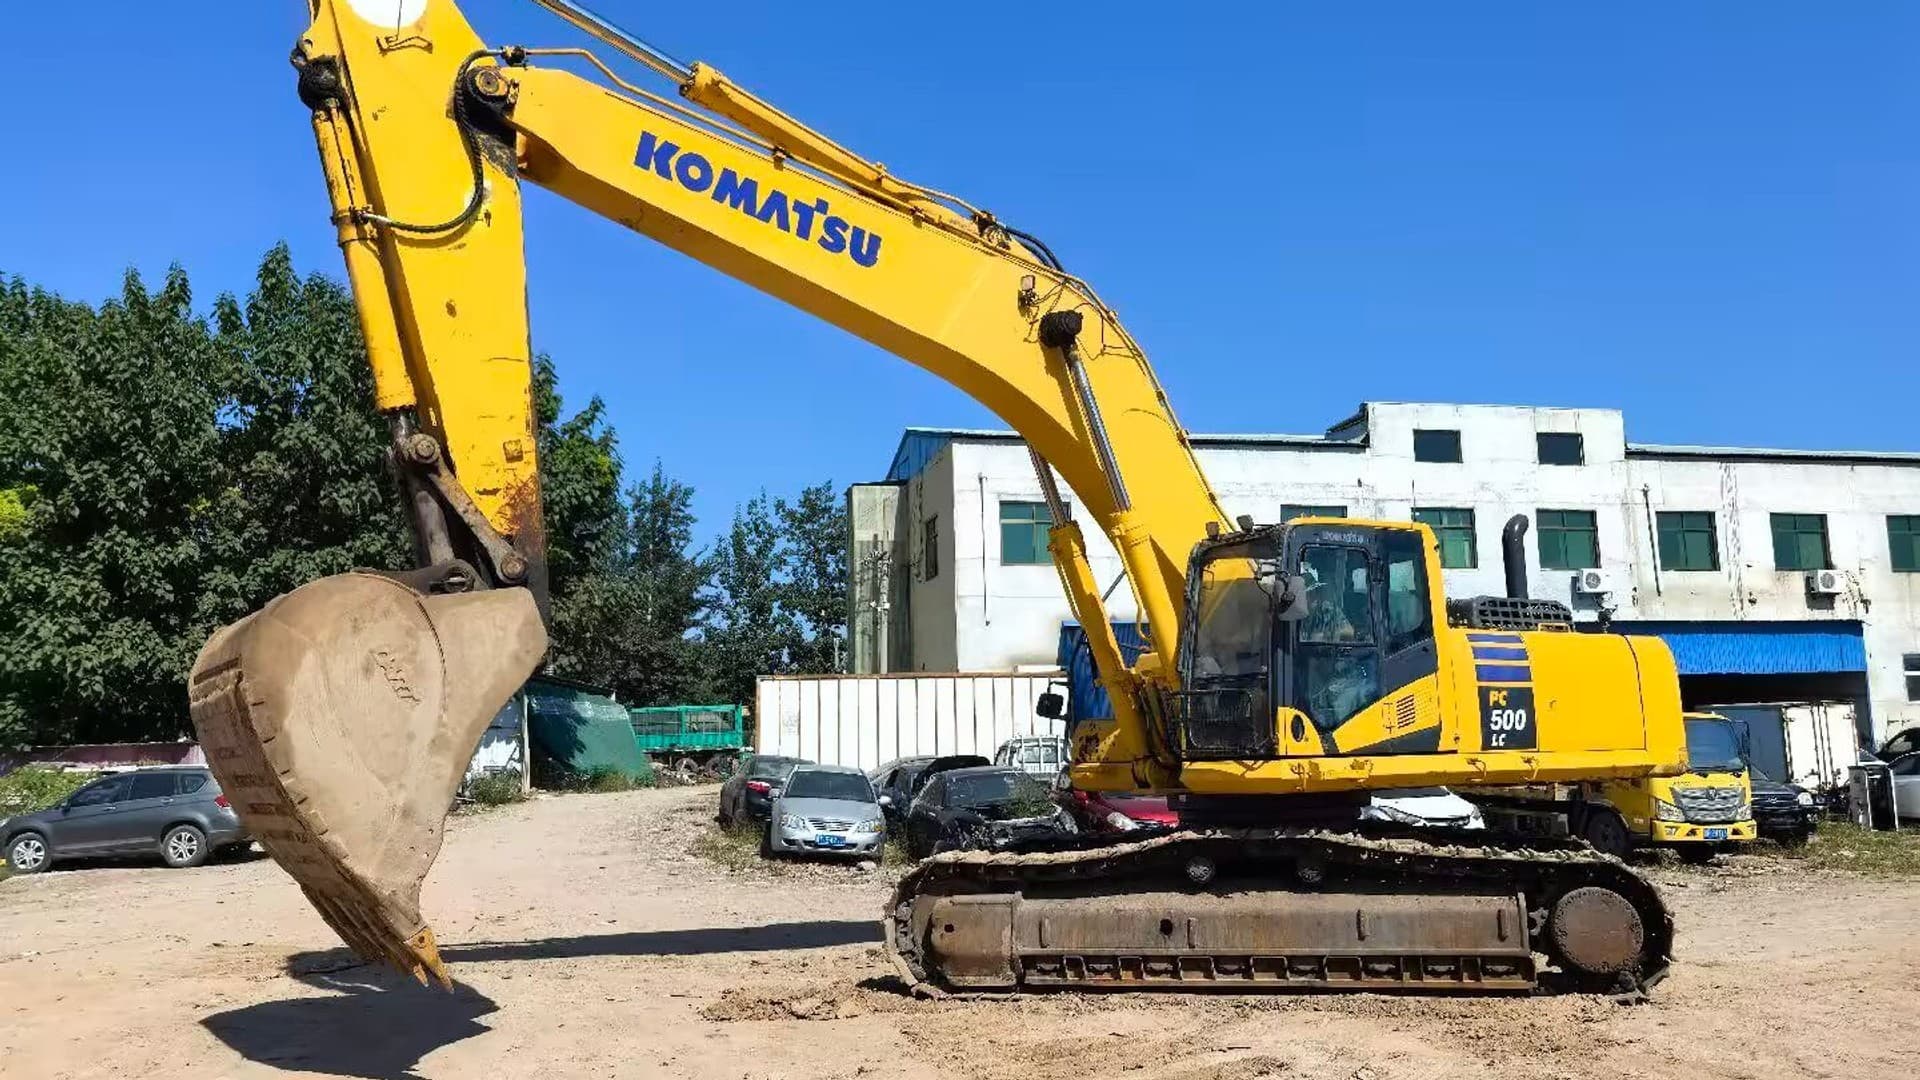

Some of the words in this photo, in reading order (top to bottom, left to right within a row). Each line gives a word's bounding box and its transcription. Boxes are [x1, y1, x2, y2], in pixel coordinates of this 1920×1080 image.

[634, 130, 882, 267] KOMATSU
[1489, 690, 1508, 706] PC
[1490, 709, 1527, 731] 500
[1491, 733, 1507, 746] LC
